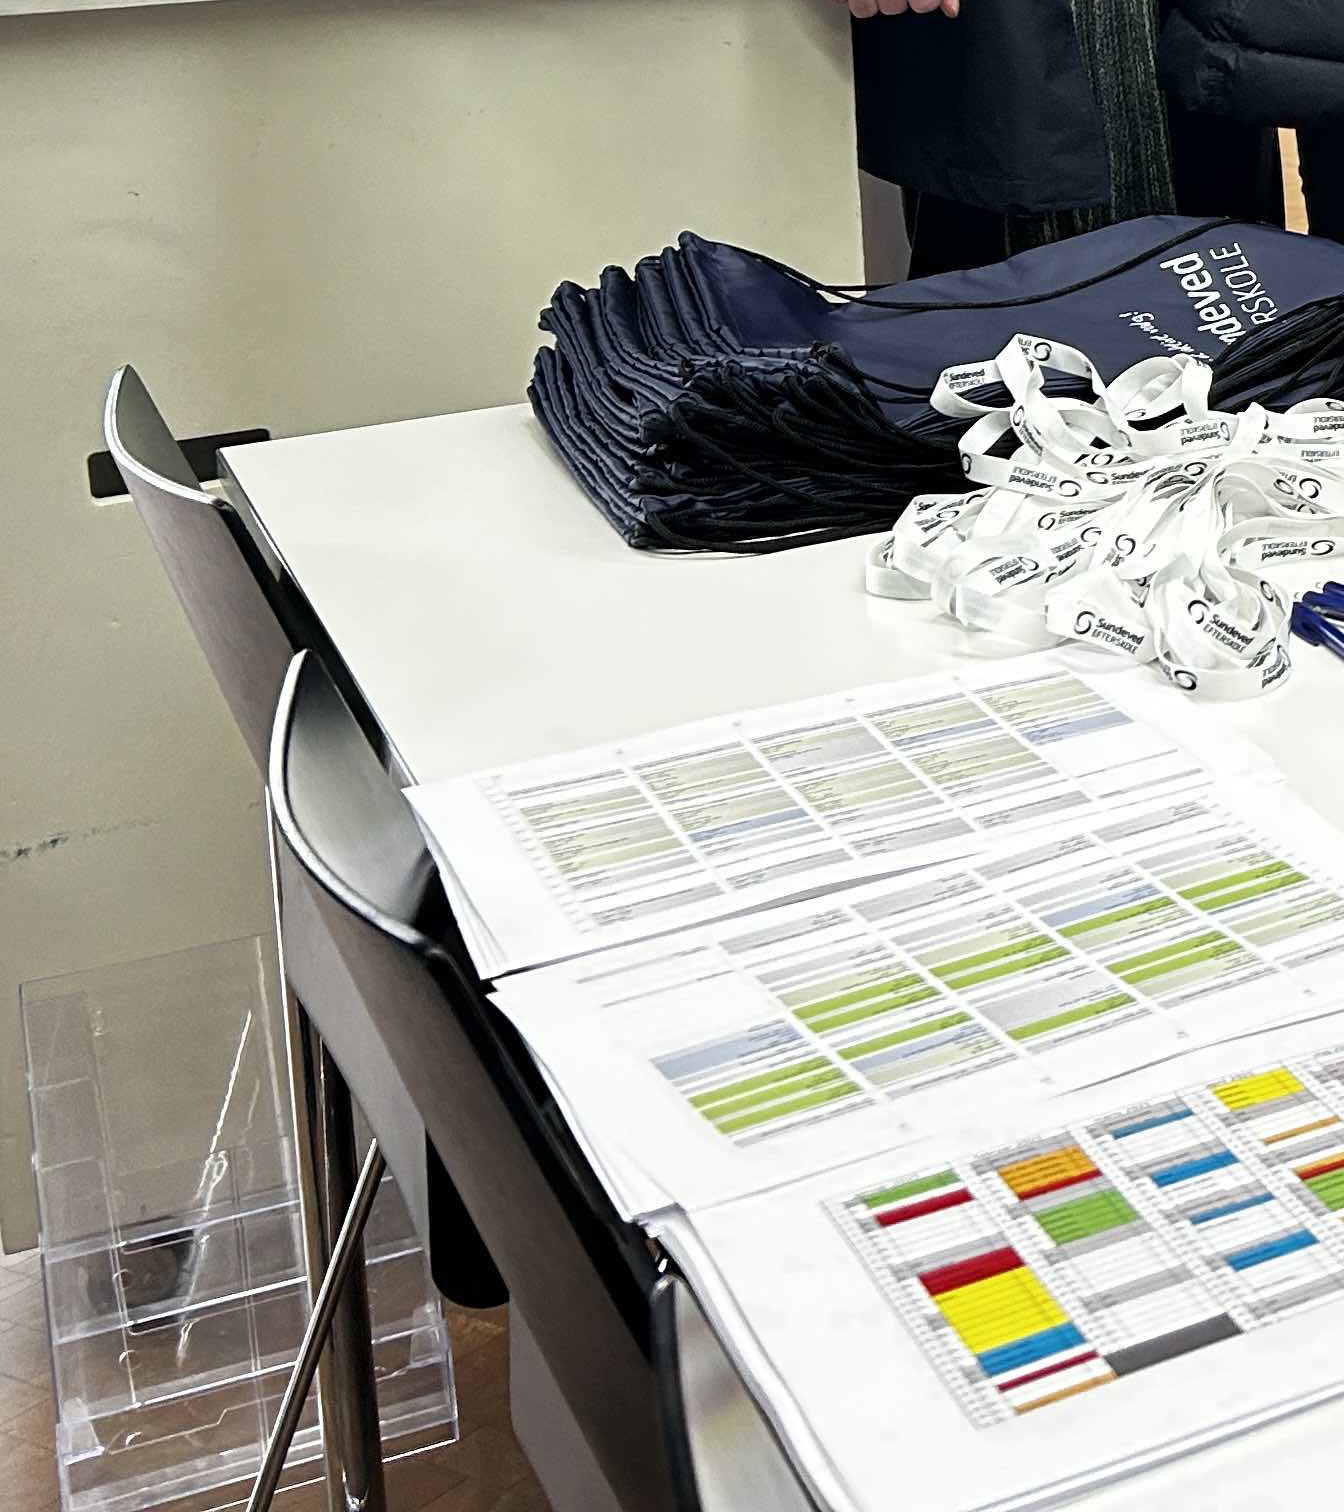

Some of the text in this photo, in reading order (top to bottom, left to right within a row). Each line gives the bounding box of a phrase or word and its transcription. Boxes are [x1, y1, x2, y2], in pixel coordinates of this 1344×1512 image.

[1159, 252, 1247, 346] ndeved
[1209, 242, 1280, 325] RSKOLE
[1096, 617, 1145, 646] Sundeved
[1209, 613, 1255, 646] Sundeved
